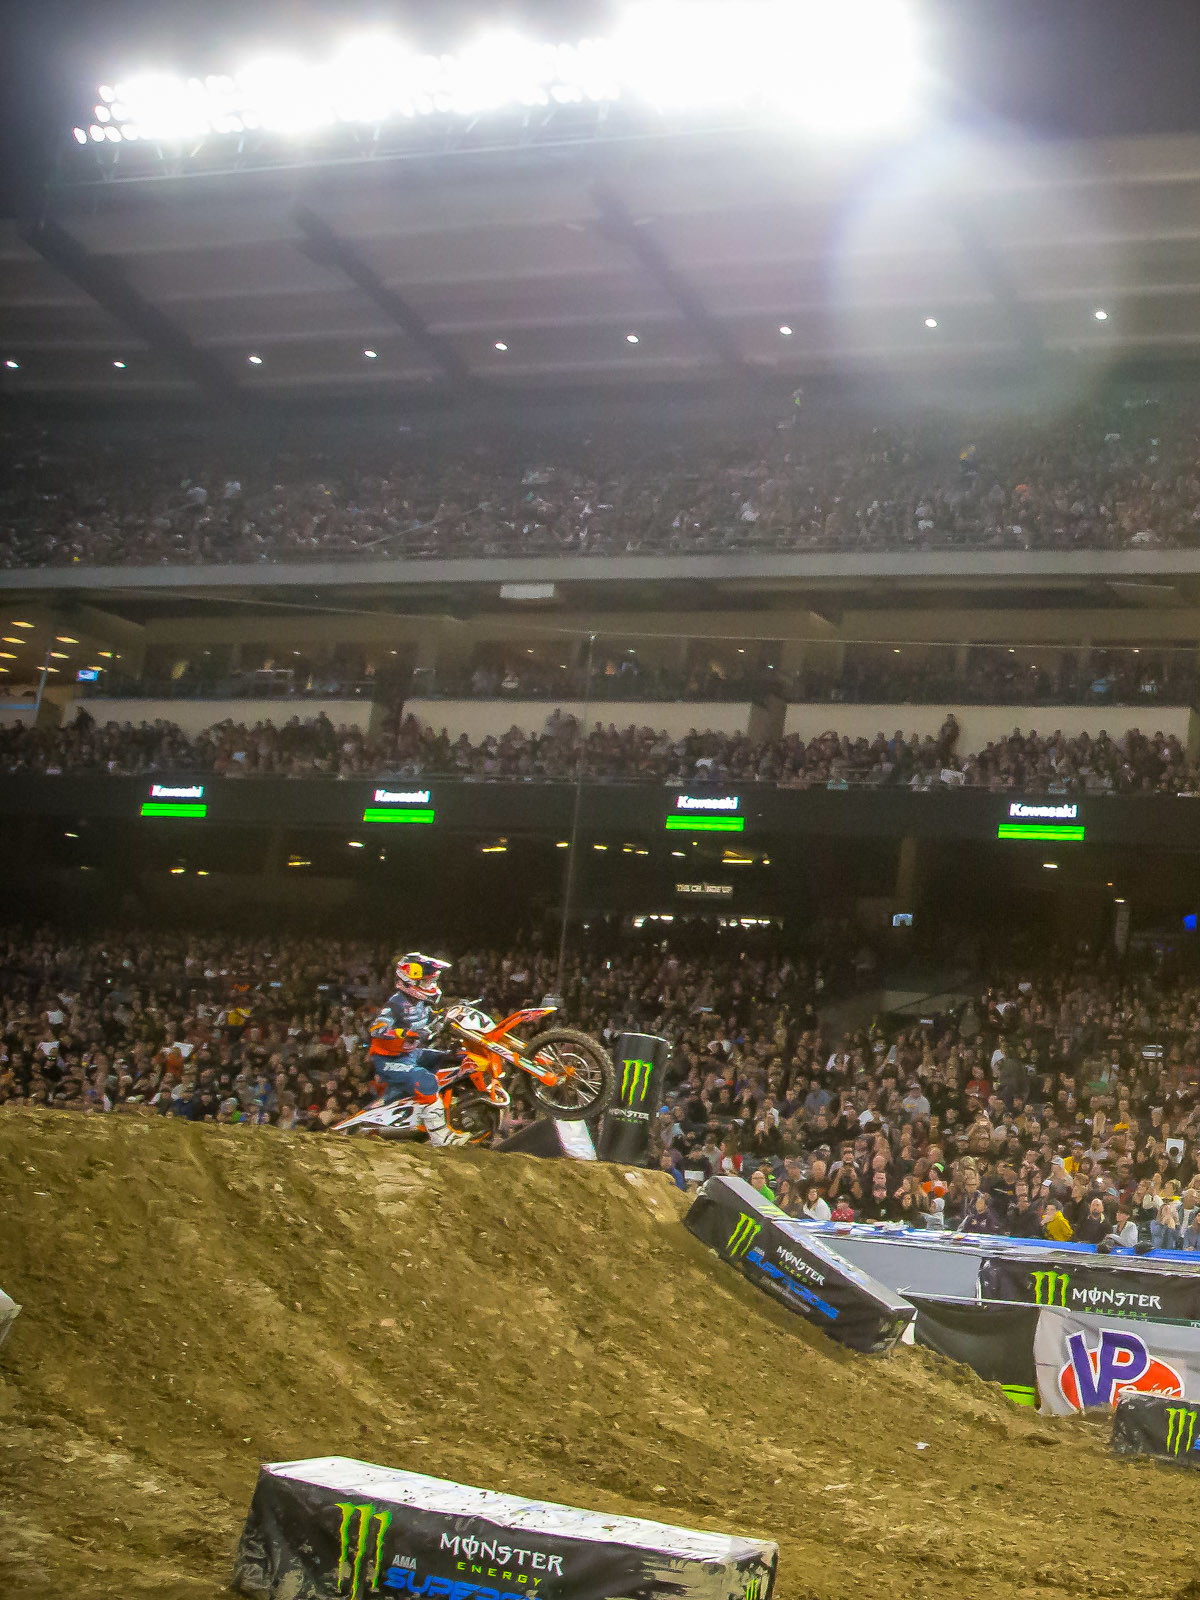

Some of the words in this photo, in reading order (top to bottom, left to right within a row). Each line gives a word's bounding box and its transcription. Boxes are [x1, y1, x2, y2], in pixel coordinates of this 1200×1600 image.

[1009, 803, 1078, 818] Kawasaki
[387, 1106, 414, 1127] 2
[776, 1246, 825, 1286] MONSTER
[1072, 1287, 1162, 1310] MONSTER
[1066, 1328, 1150, 1407] VP
[391, 1554, 417, 1570] AMA
[440, 1532, 564, 1577] MONSTER
[456, 1561, 543, 1587] ENERGY
